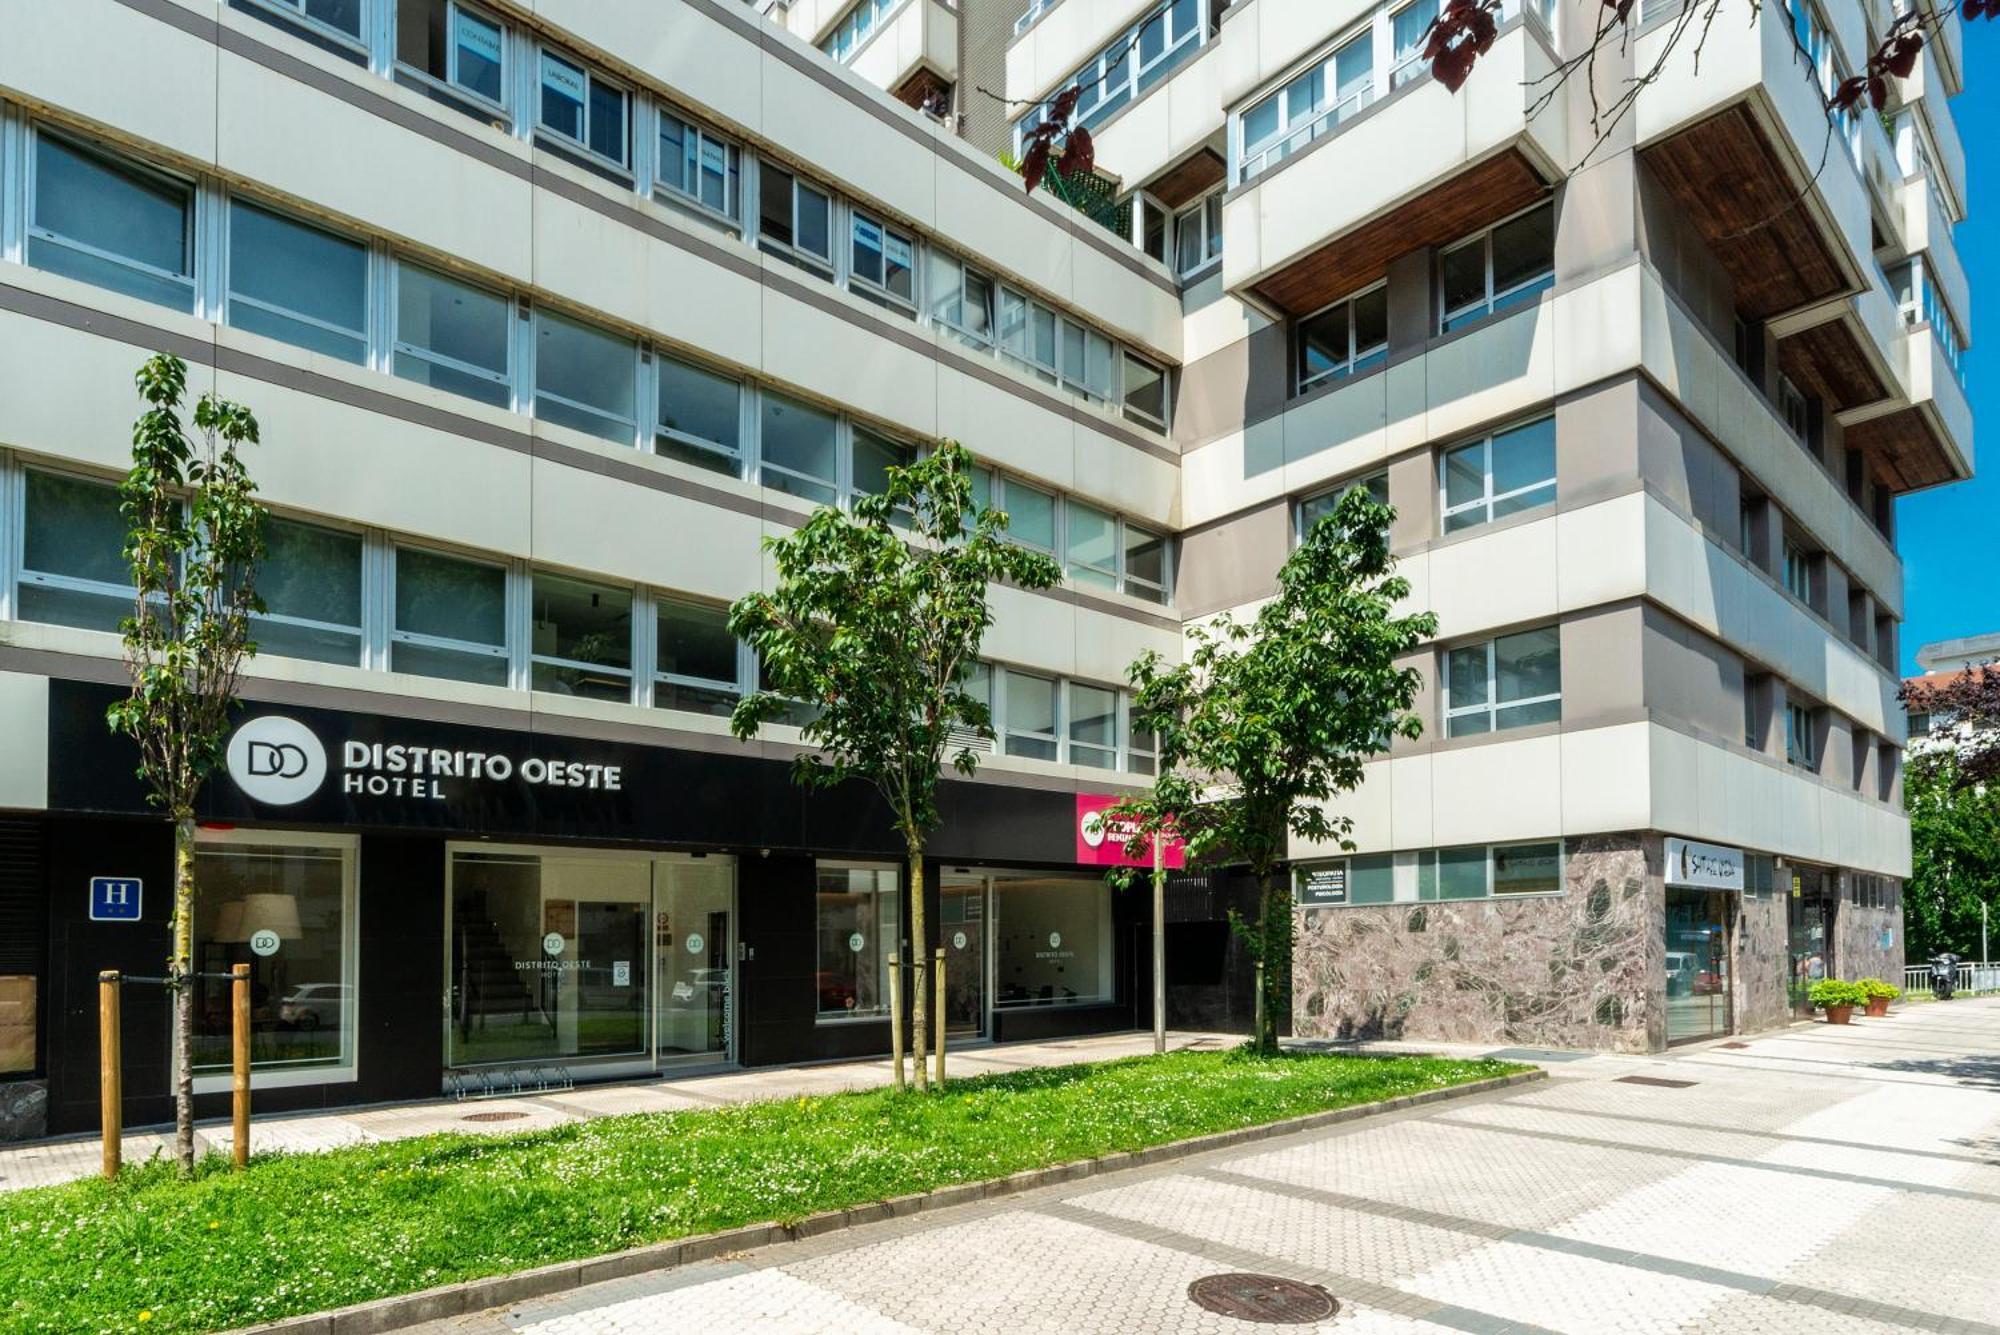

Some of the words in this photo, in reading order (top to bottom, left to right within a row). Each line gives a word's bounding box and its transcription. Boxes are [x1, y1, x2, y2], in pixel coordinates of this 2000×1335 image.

[344, 740, 512, 781] DISTRITO
[521, 758, 621, 790] OESTE
[344, 773, 446, 800] HOTEL
[104, 883, 129, 904] H
[515, 960, 559, 970] DISTRITO
